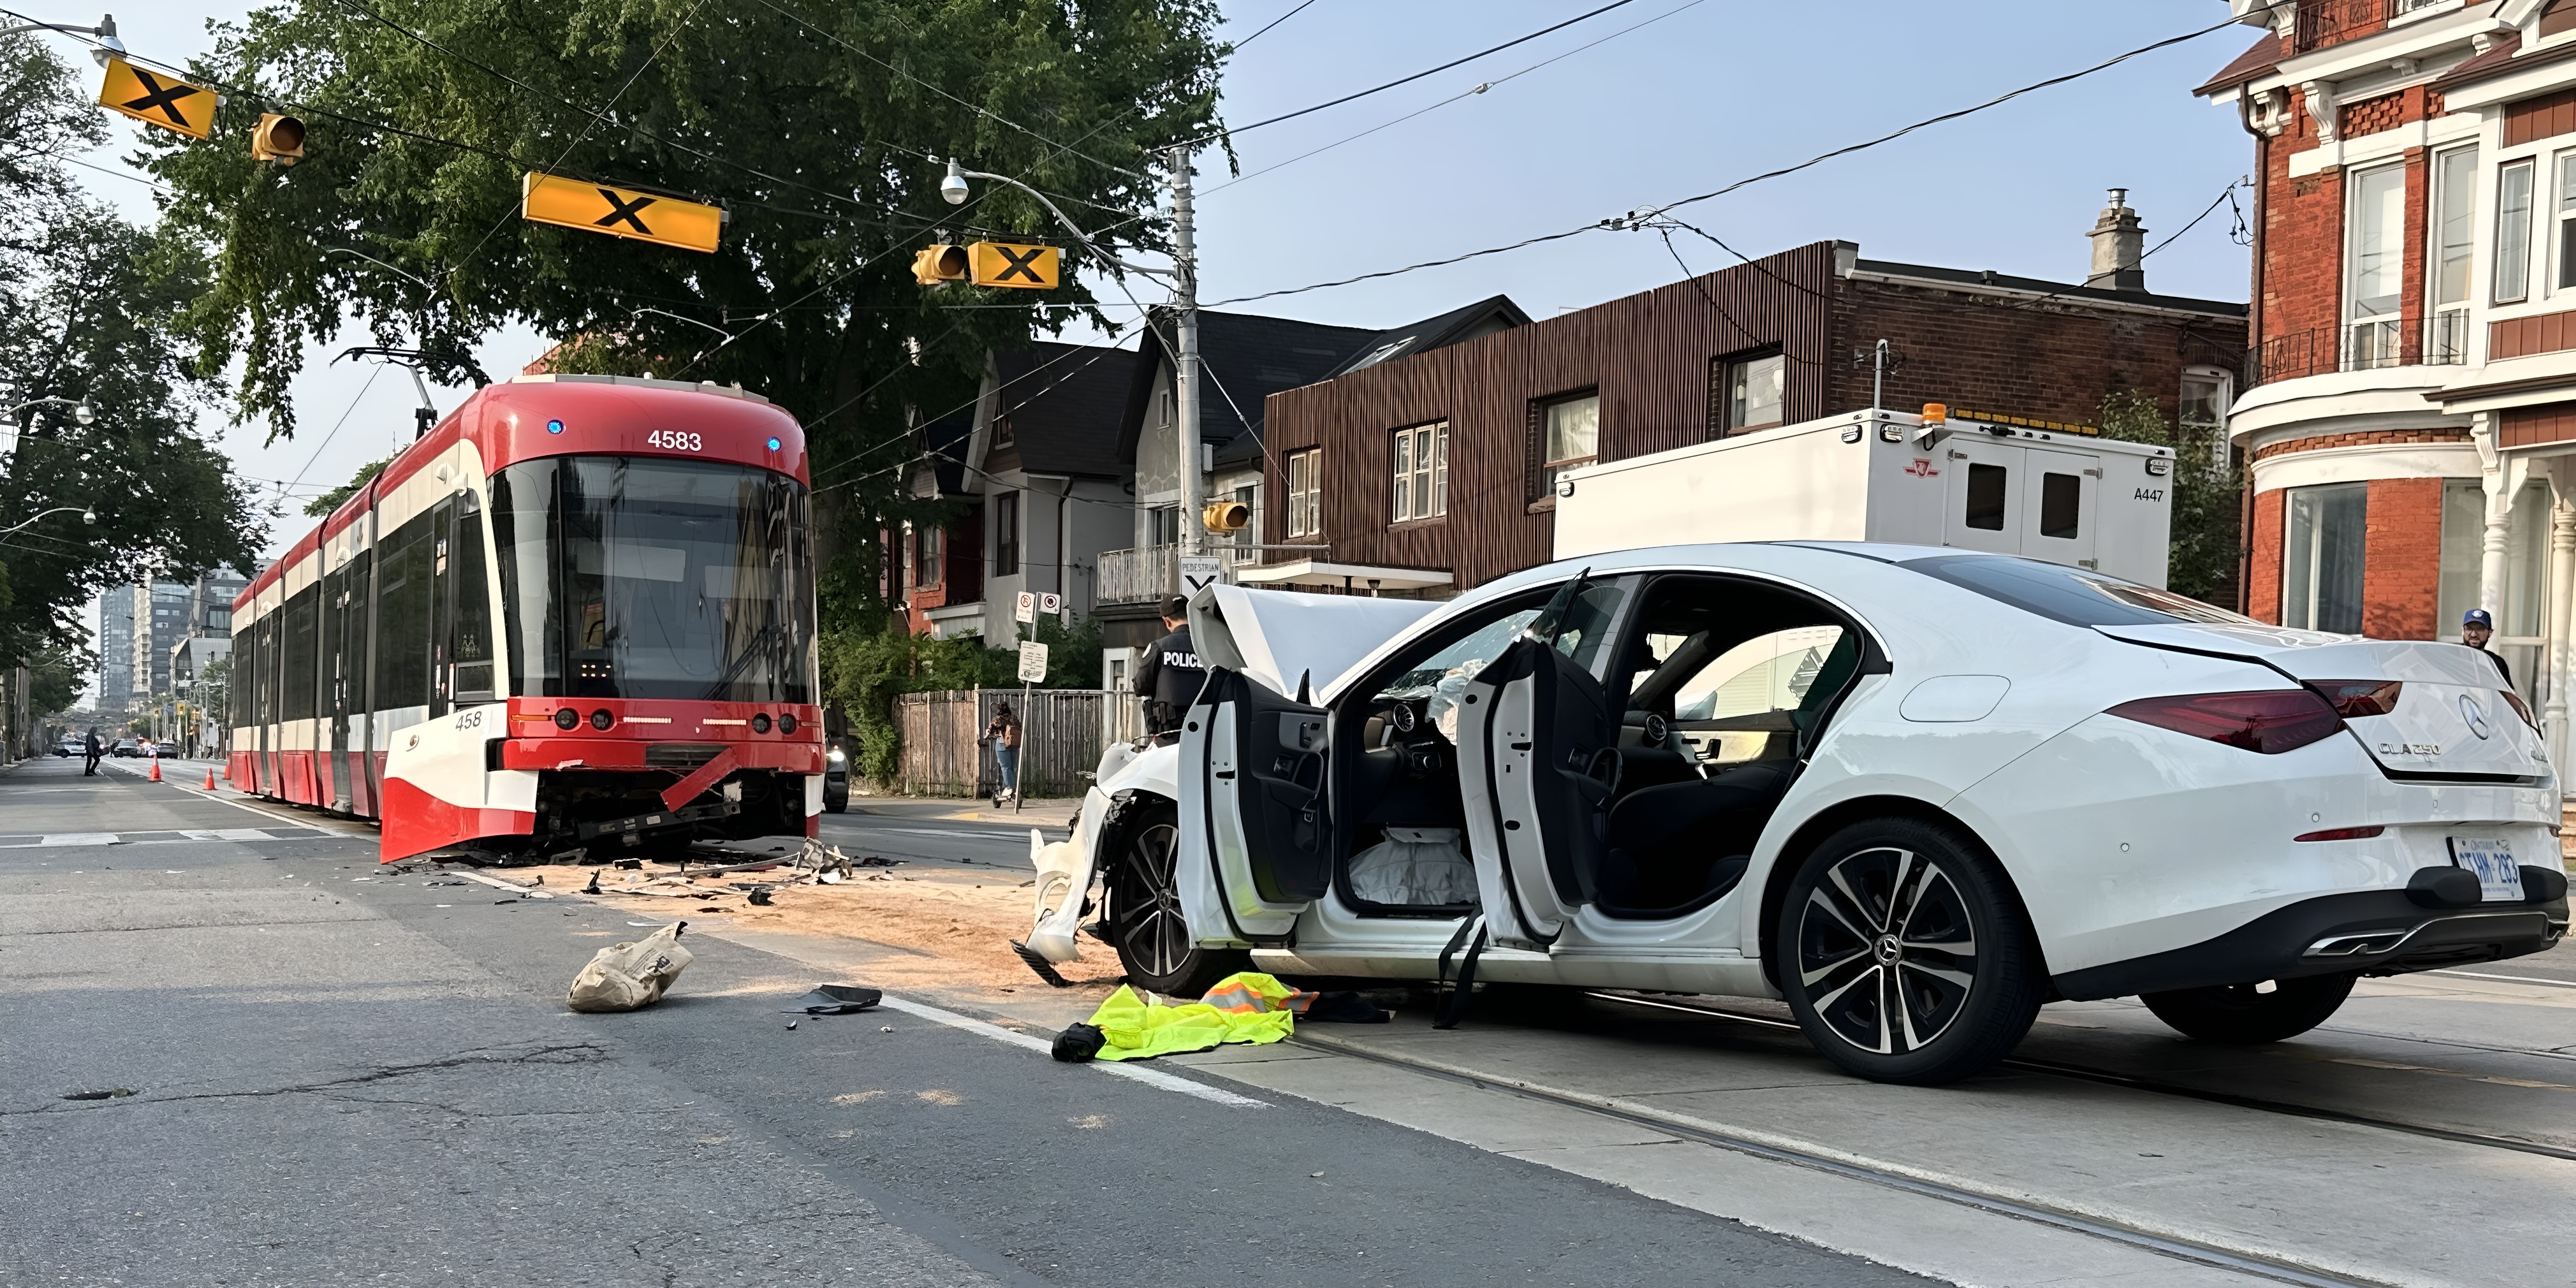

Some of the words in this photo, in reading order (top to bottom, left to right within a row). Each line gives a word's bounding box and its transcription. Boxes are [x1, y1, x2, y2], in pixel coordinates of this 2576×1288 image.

[648, 430, 702, 451] 4583
[2134, 488, 2164, 502] A447
[1182, 563, 1219, 572] PEDESTRIAN
[2378, 743, 2412, 755] CLA
